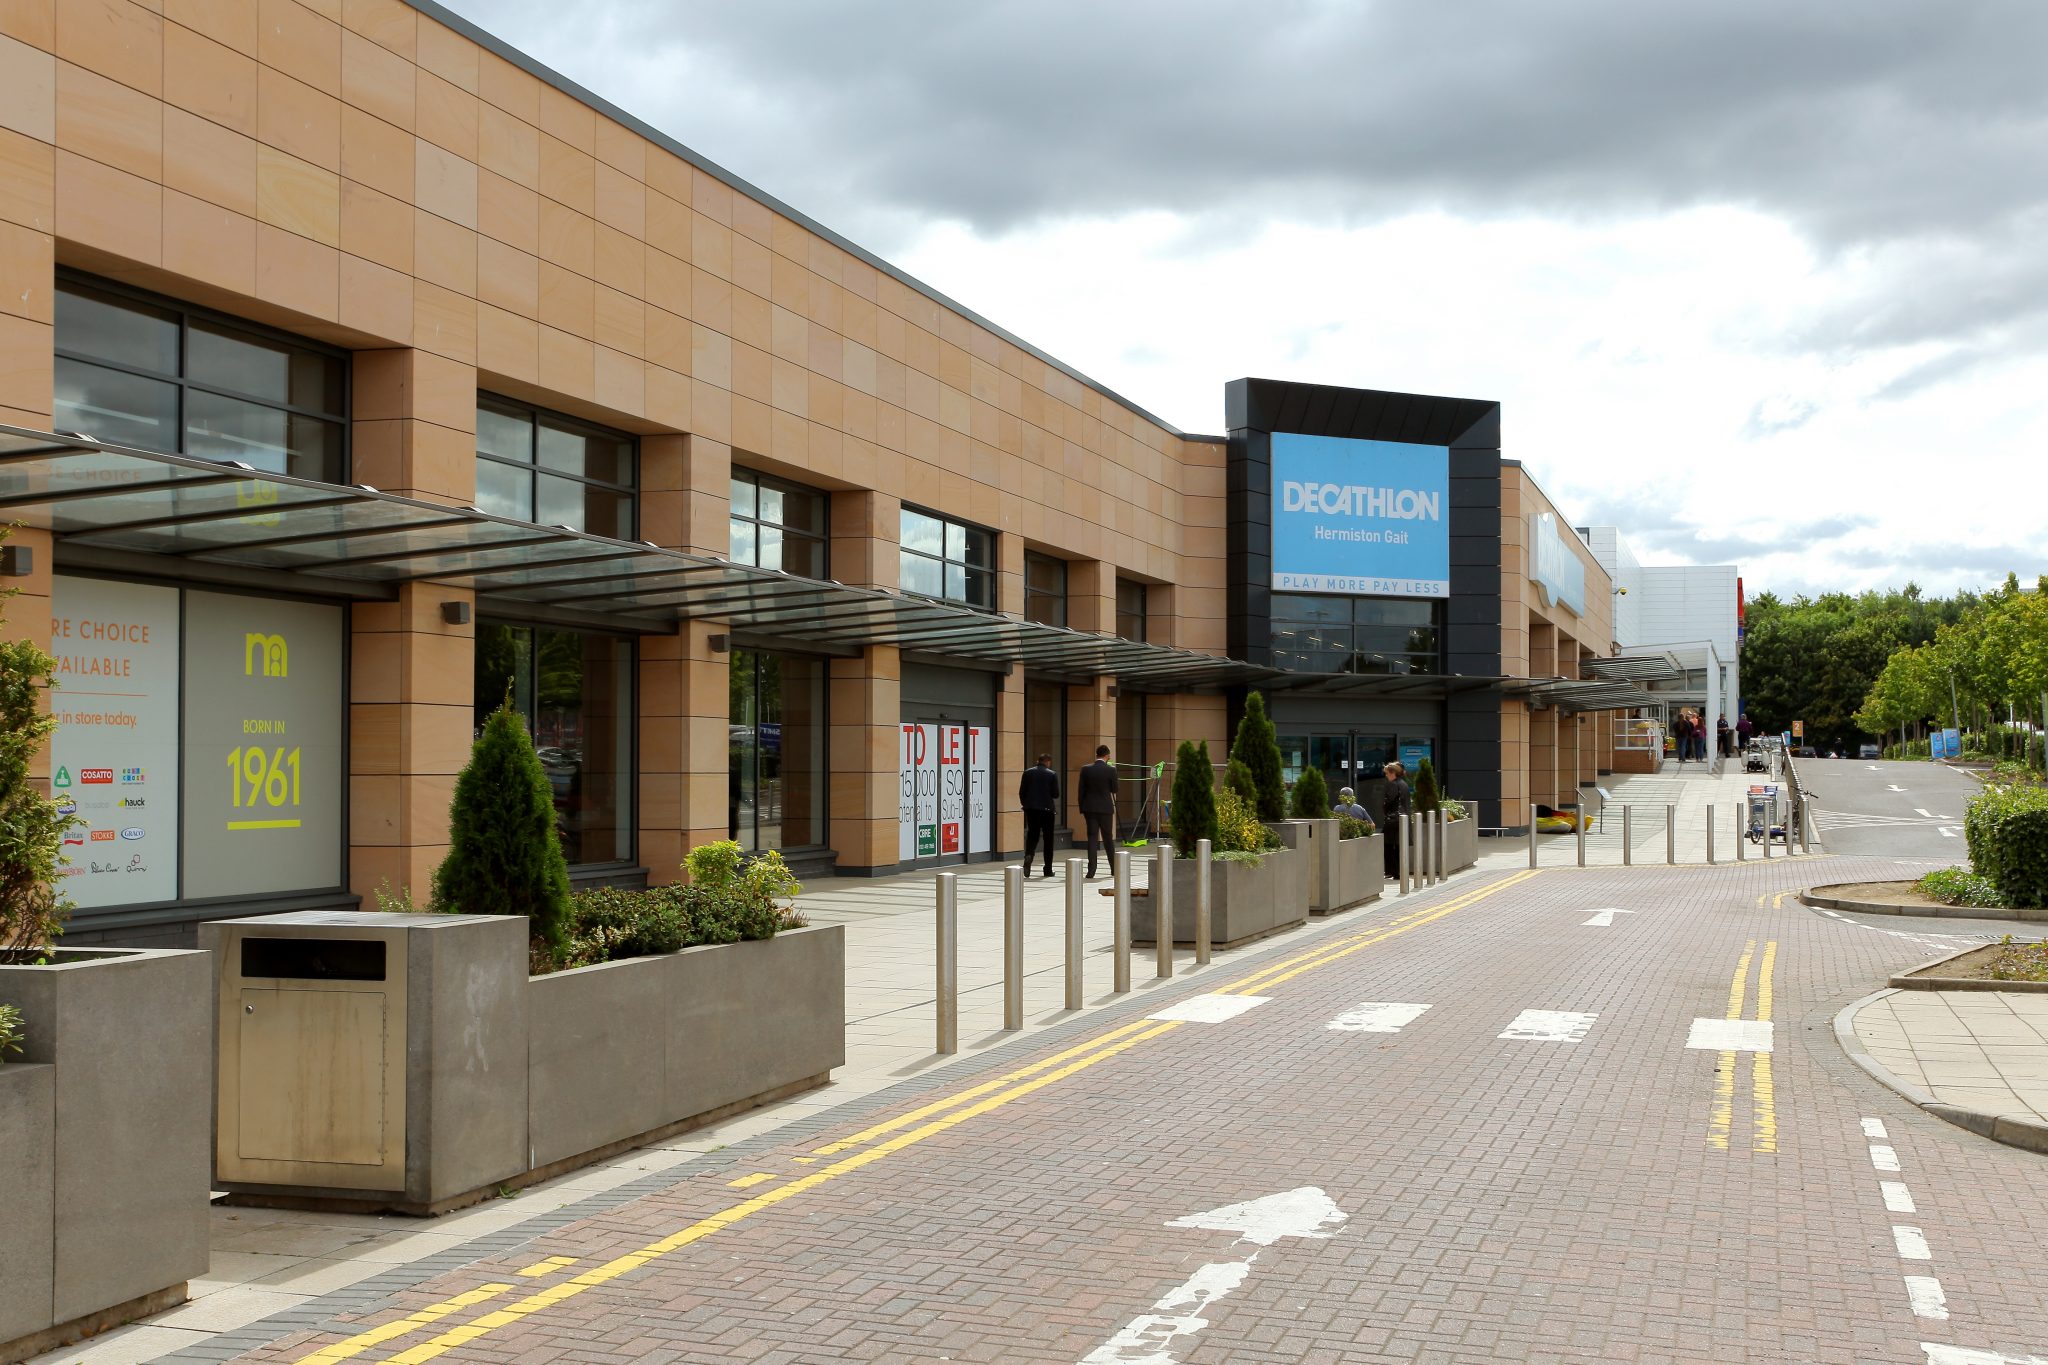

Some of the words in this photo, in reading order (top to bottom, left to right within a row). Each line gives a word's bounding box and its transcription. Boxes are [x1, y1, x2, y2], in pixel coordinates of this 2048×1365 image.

[1283, 481, 1439, 521] DECATHLON
[1315, 525, 1380, 543] Hermiston
[1384, 530, 1408, 544] Gait
[1283, 577, 1318, 588] PLAY
[1327, 578, 1366, 590] MORE
[1373, 581, 1399, 592] PAY
[1406, 582, 1439, 594] LESS
[51, 618, 71, 638] RE
[80, 620, 149, 643] CHOICE
[62, 709, 72, 724] in
[75, 711, 102, 725] store
[243, 719, 271, 734] BORN
[275, 720, 285, 734] IN
[1794, 723, 1800, 731] 2
[941, 728, 979, 765] LET
[82, 771, 112, 779] COSATTO
[227, 746, 301, 807] 1961
[92, 832, 113, 840] STOKKE
